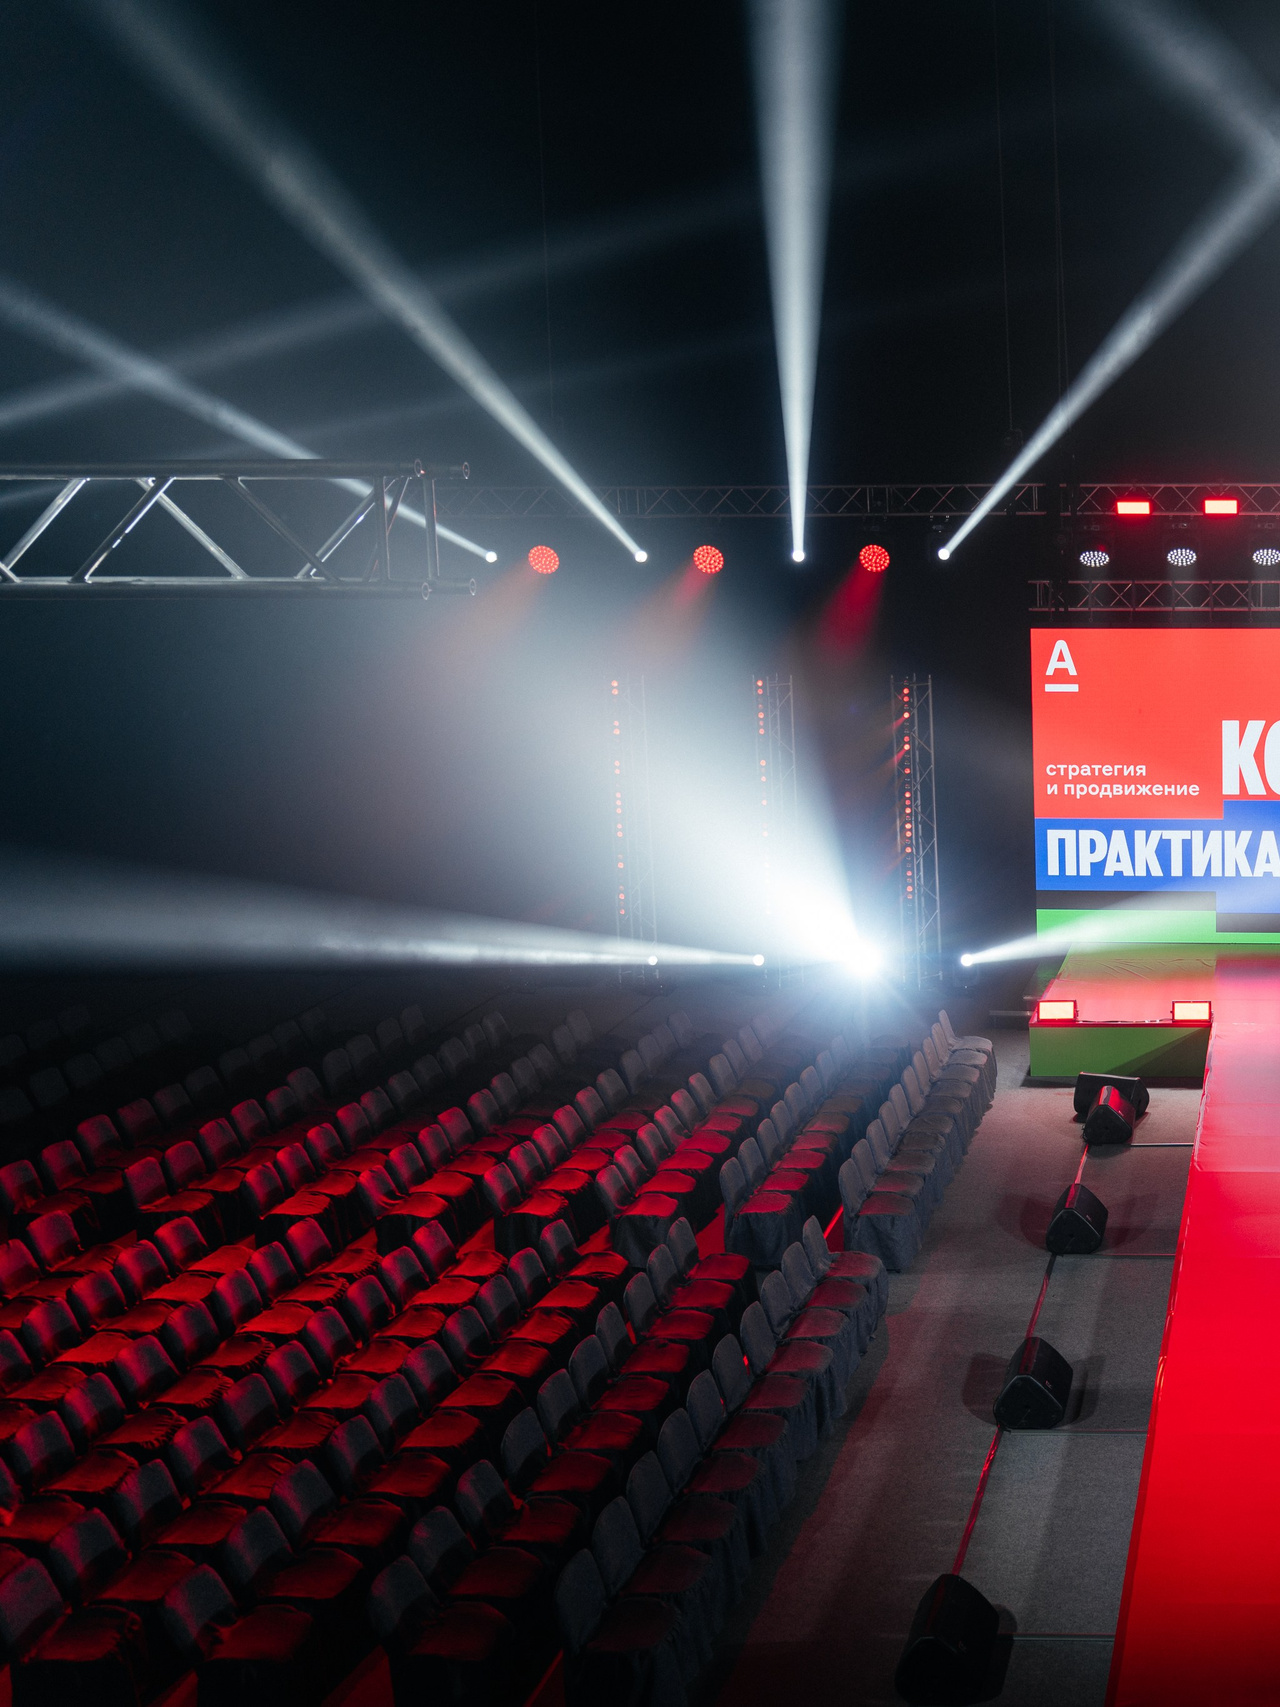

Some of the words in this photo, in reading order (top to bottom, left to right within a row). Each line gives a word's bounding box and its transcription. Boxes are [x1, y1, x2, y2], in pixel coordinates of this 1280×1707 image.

[1045, 640, 1078, 675] А
[1046, 764, 1146, 780] стратегия
[1046, 783, 1058, 796] и
[1064, 782, 1200, 799] продвижение
